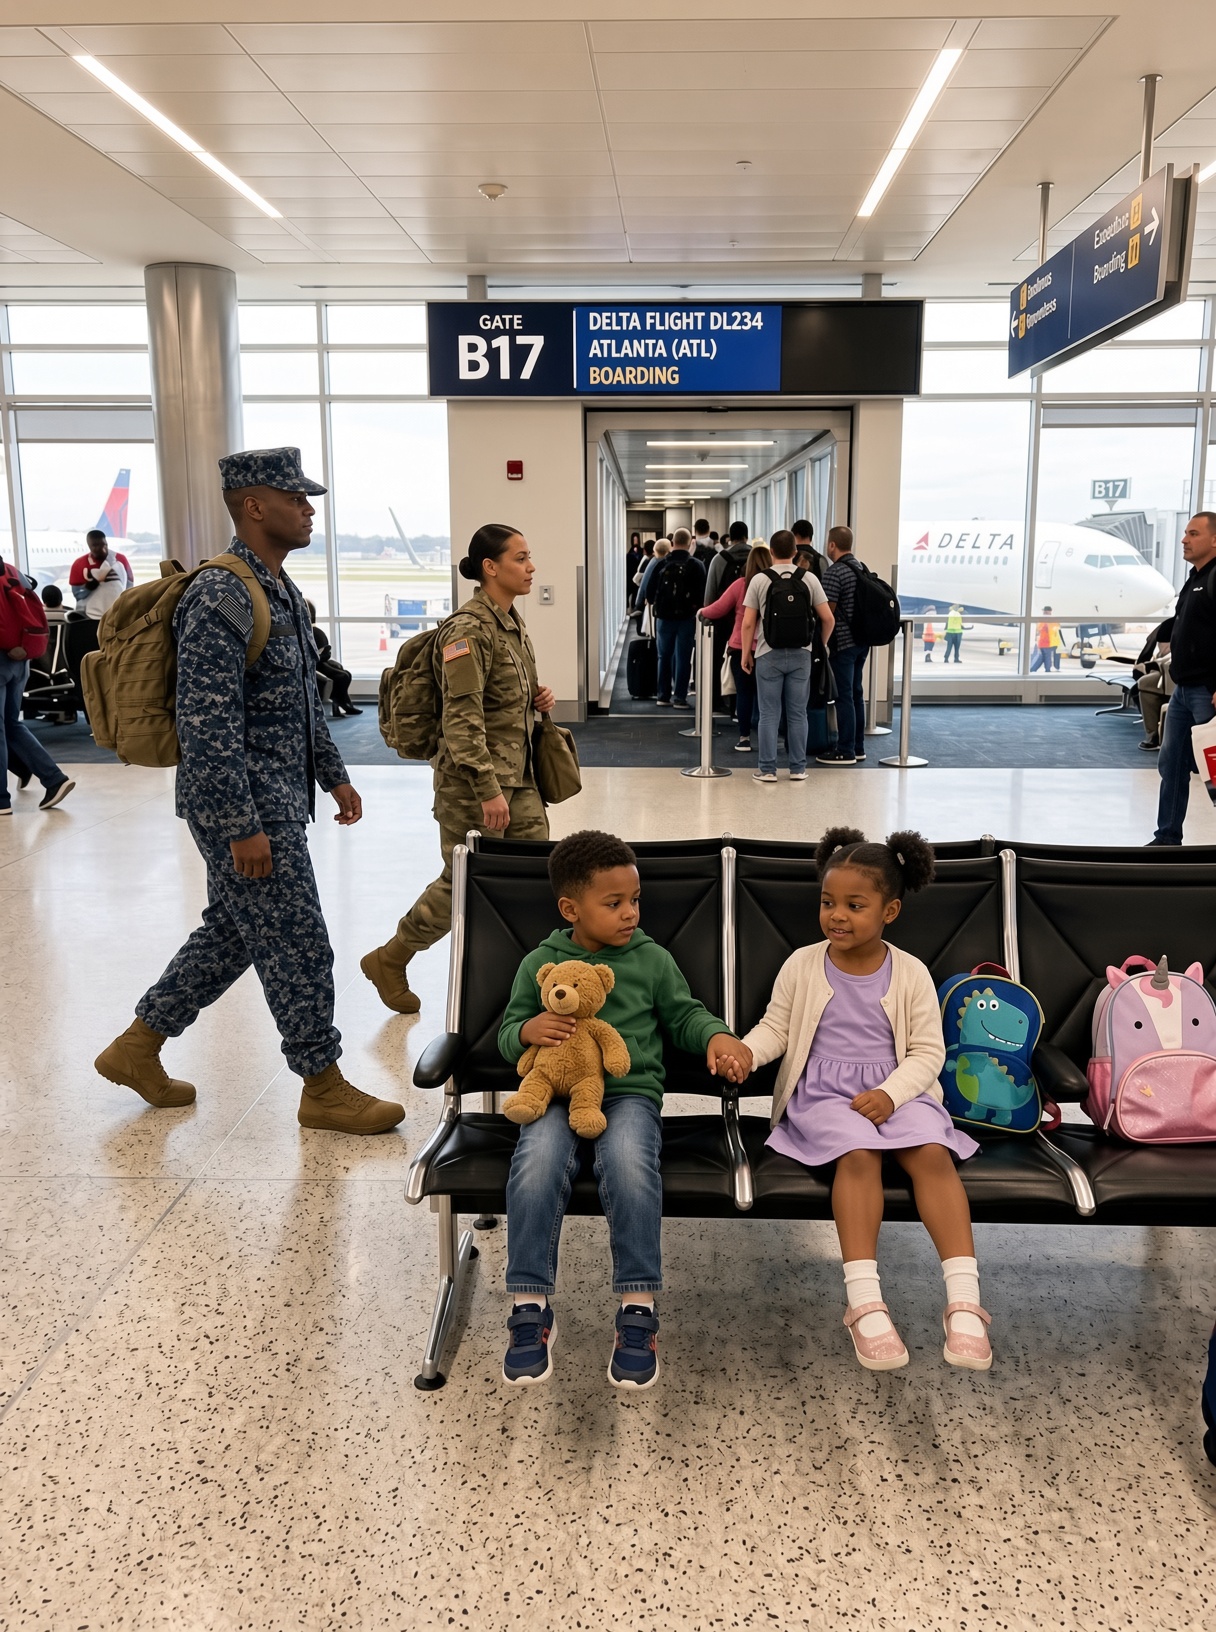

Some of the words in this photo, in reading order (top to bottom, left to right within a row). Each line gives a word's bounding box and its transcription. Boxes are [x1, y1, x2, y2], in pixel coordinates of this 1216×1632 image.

[479, 314, 523, 330] GATE
[589, 312, 642, 331] DELTA
[645, 312, 706, 331] FLIGHT
[709, 312, 764, 331] DL234
[458, 334, 545, 380] B17
[588, 339, 668, 358] ATLANTA
[671, 338, 717, 360] (ATL)
[588, 366, 680, 385] BOARDING
[1094, 481, 1125, 497] B17
[937, 532, 1014, 550] DELTA
